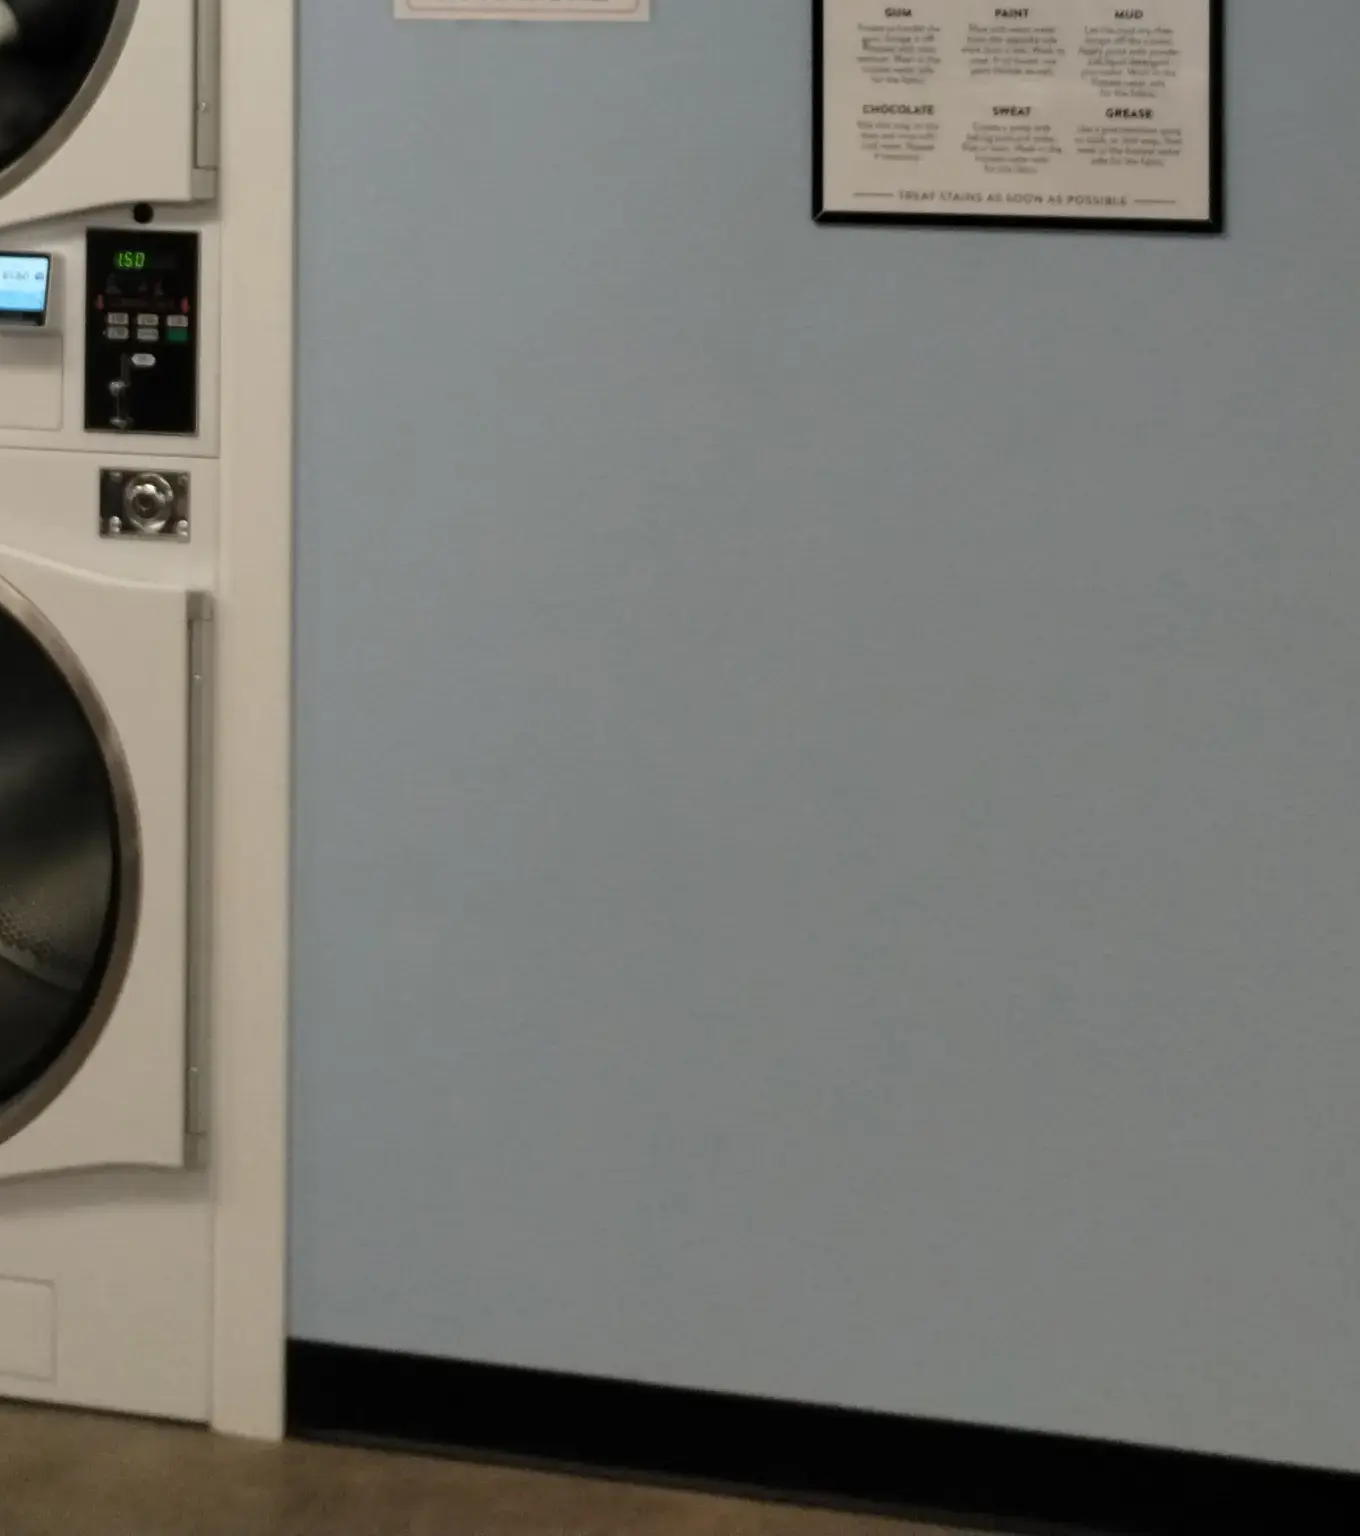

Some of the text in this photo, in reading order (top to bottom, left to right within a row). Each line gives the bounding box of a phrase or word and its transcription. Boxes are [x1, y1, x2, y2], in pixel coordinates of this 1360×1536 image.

[884, 7, 913, 19] GUM
[994, 7, 1030, 20] PAINT
[1113, 8, 1144, 20] MUD
[862, 104, 935, 117] CHOCOLATE
[991, 105, 1032, 118] SWEAT
[1104, 107, 1155, 120] GREASE
